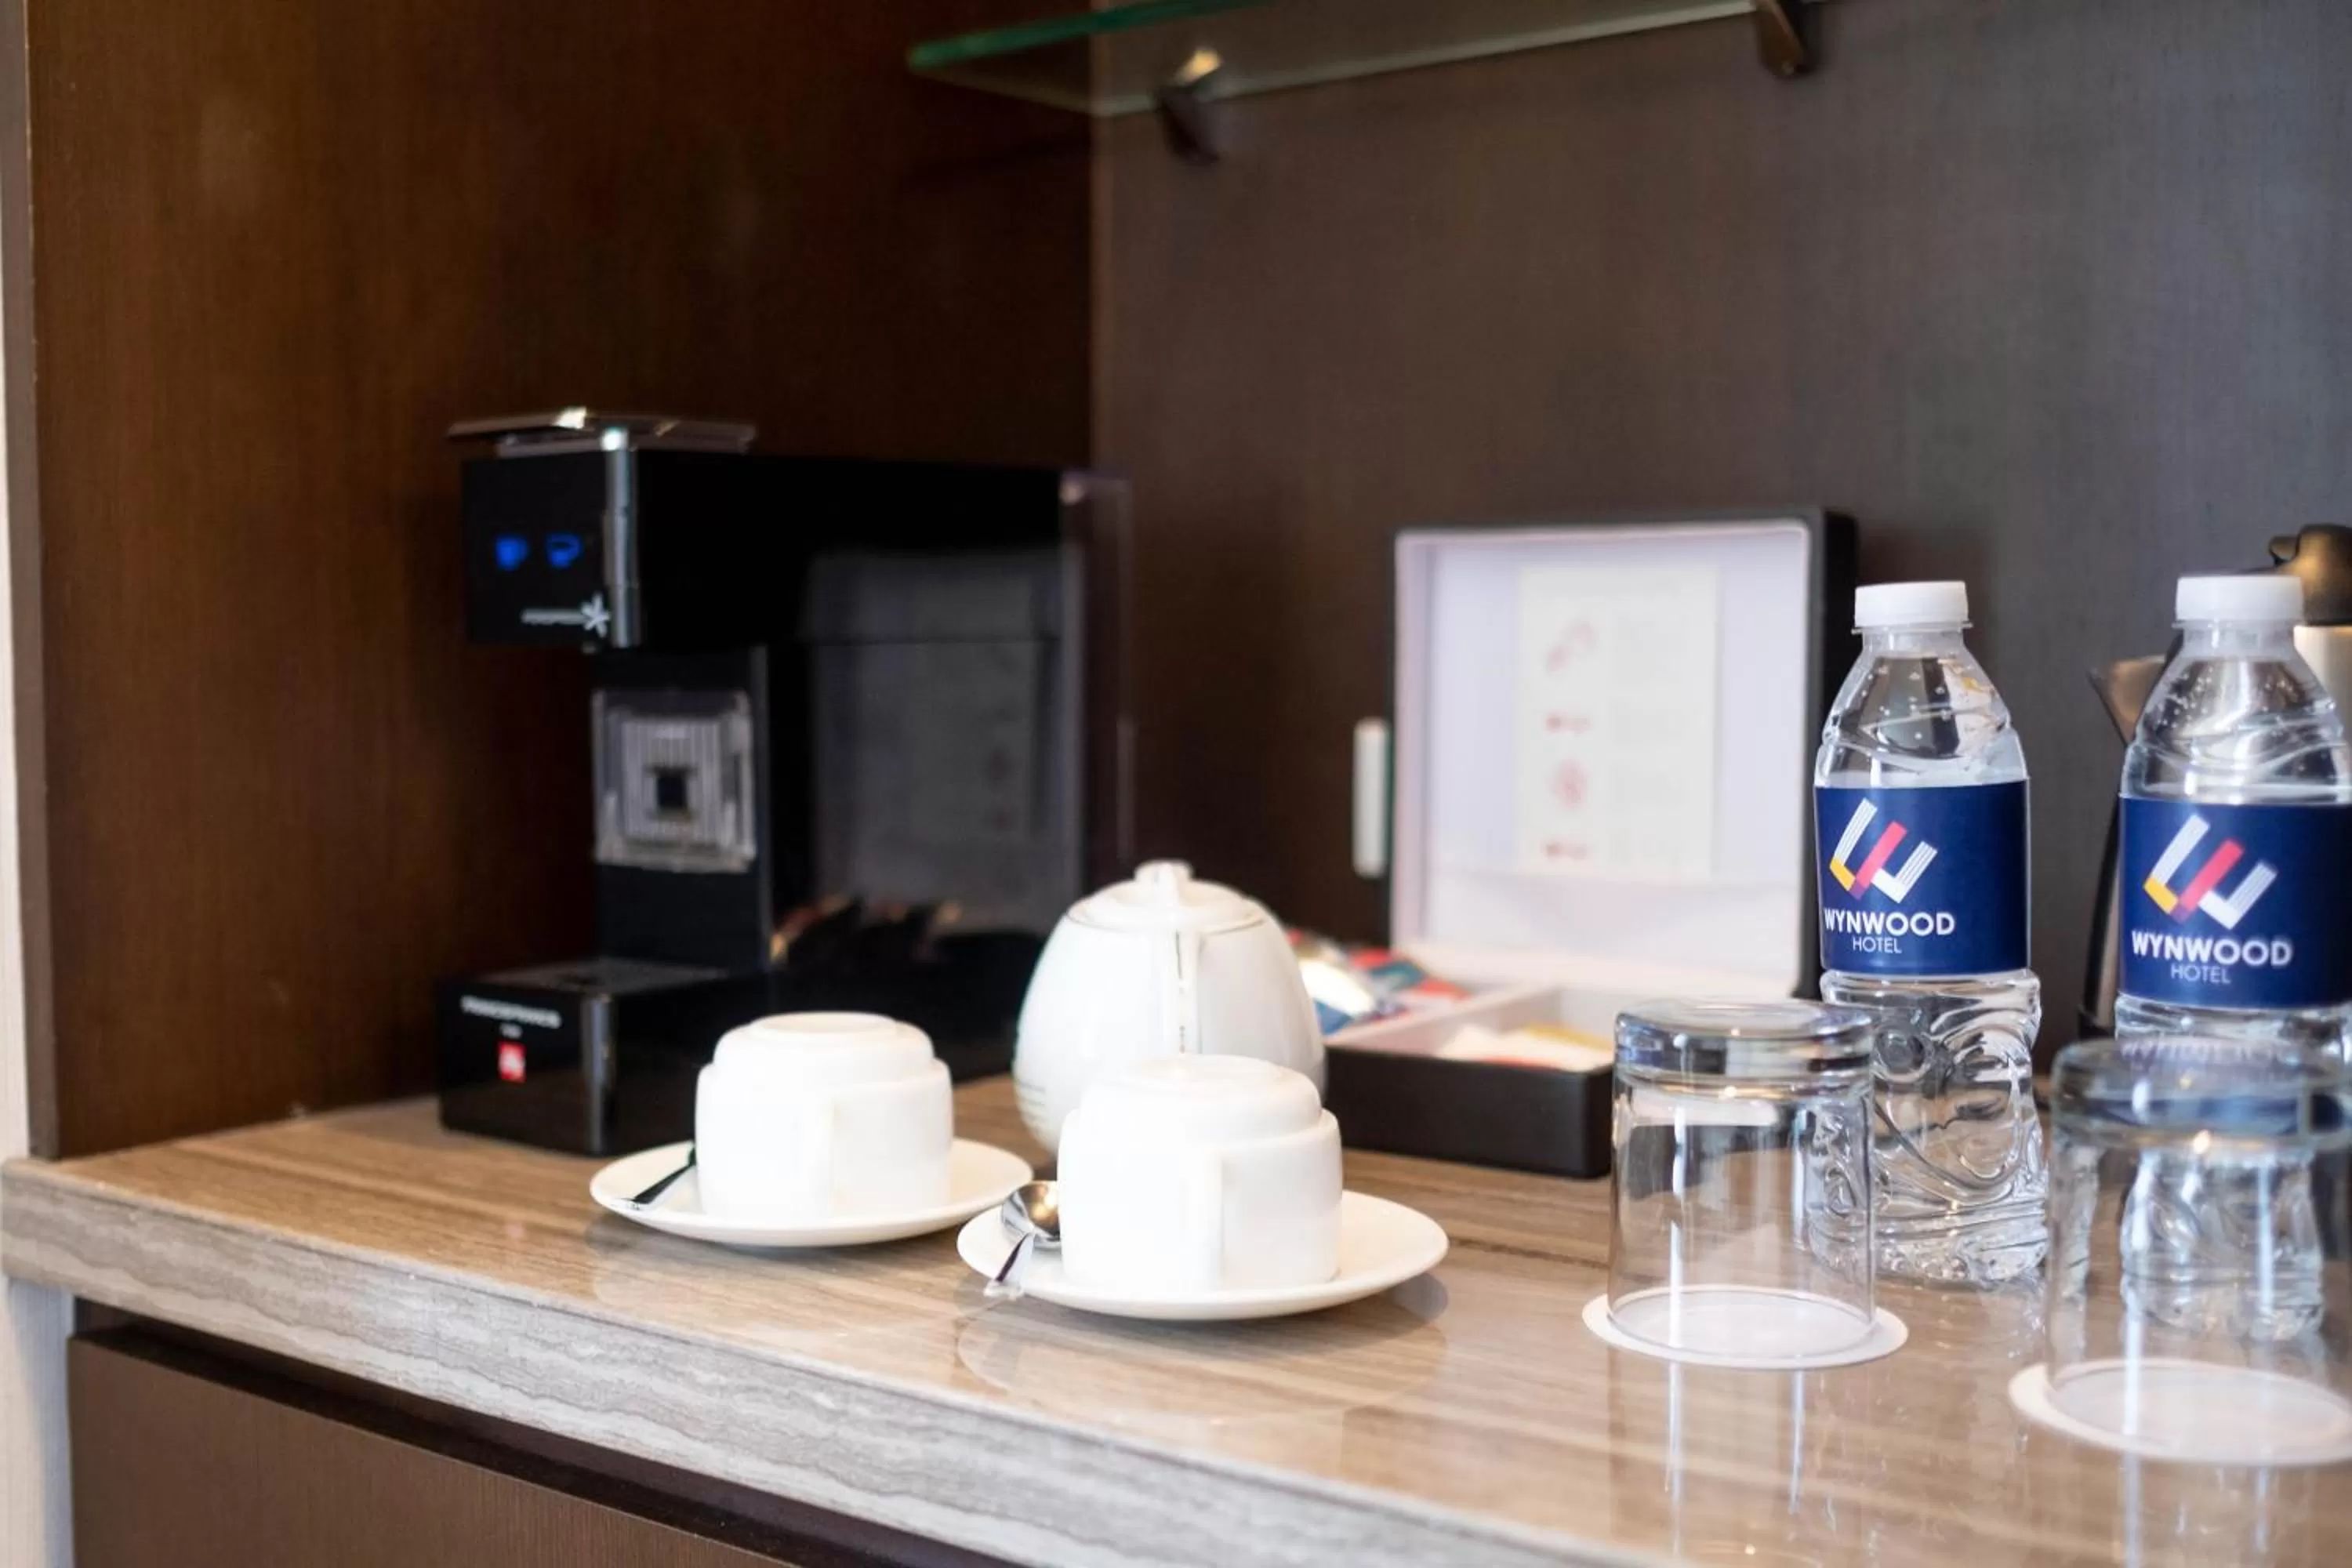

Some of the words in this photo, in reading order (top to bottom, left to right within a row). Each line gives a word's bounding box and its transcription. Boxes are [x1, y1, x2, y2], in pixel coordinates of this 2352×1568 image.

[1824, 908, 1955, 936] WYNWOOD
[1853, 938, 1902, 954] HOTEL
[2132, 931, 2293, 967] WYNWOOD
[2171, 964, 2231, 984] HOTEL
